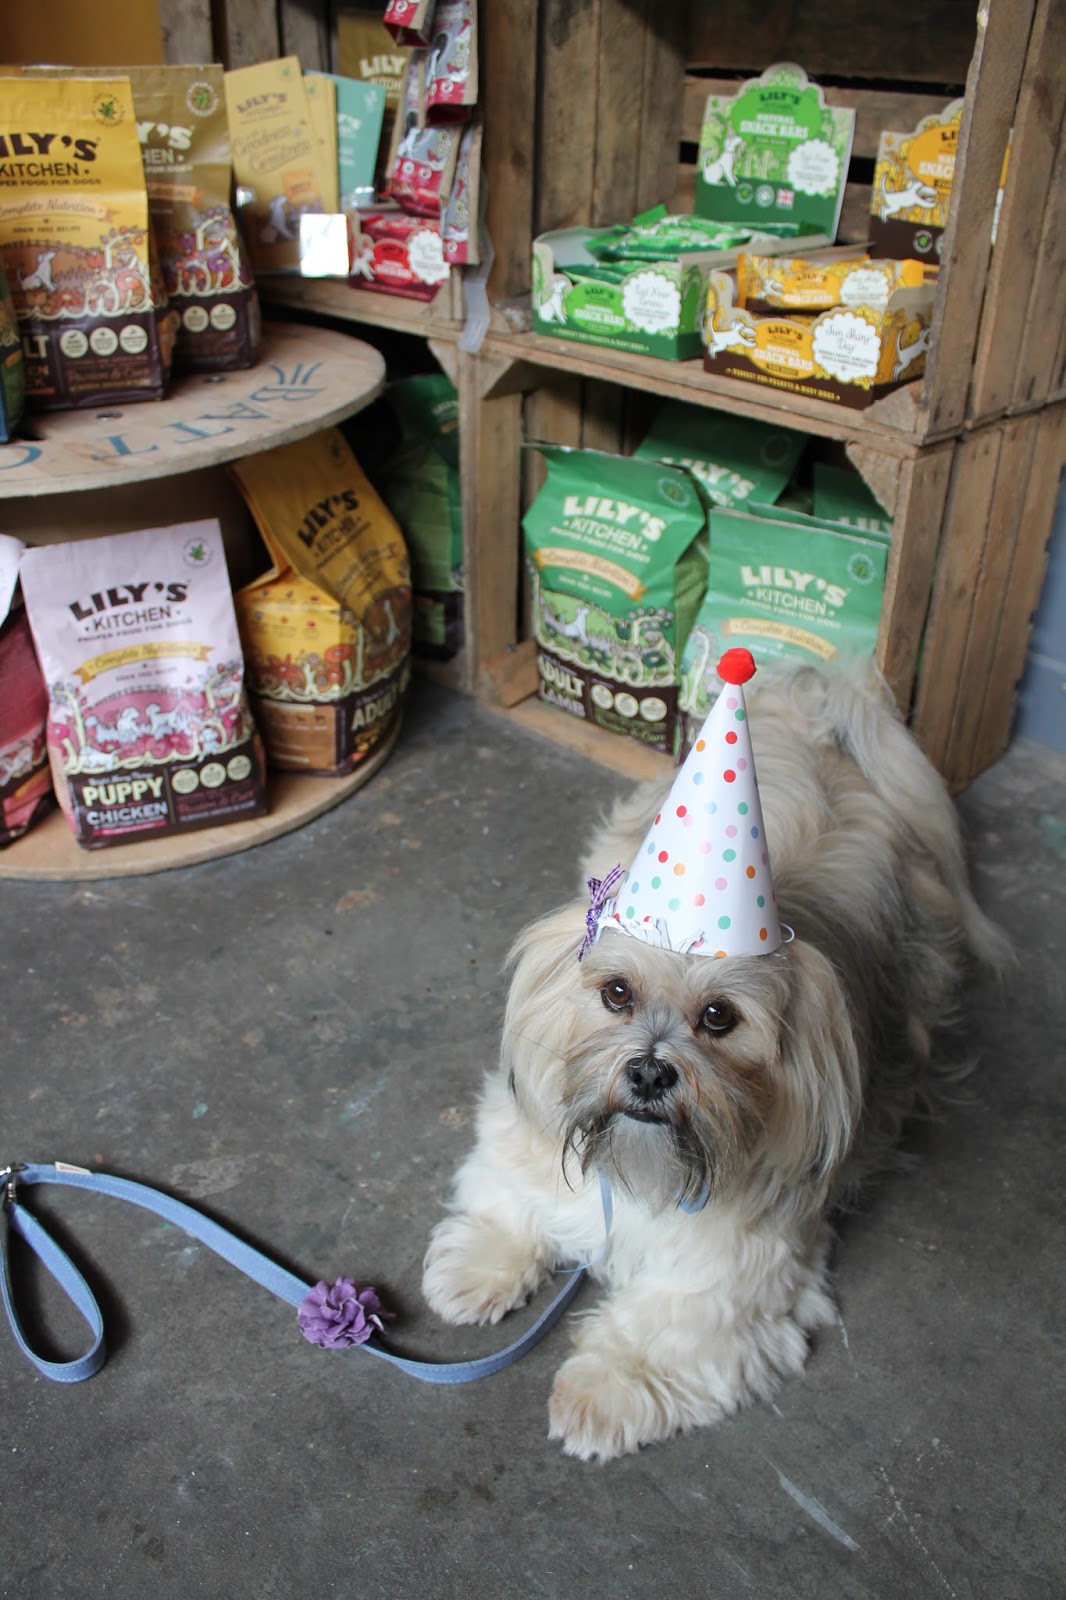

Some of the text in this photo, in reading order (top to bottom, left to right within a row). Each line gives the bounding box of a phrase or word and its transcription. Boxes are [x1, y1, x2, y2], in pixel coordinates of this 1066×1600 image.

[760, 91, 801, 105] LILY'S
[740, 120, 809, 139] SNACK BARS
[768, 325, 803, 341] LILY'S
[825, 323, 873, 345] Sun Shiny
[753, 348, 786, 366] SNACK
[787, 356, 814, 371] BARS
[296, 489, 361, 548] LILY'S
[563, 496, 667, 542] LILY'S
[569, 517, 643, 551] KITCHEN
[739, 565, 848, 608] LILY'S
[68, 581, 189, 622] LILY'S
[756, 587, 828, 616] KITCHEN
[773, 605, 798, 617] FOOD
[93, 605, 173, 632] KITCHEN
[116, 626, 143, 637] FOOD
[145, 623, 163, 632] FOR
[82, 776, 163, 807] PUPPY
[86, 801, 168, 826] CHICKEN
